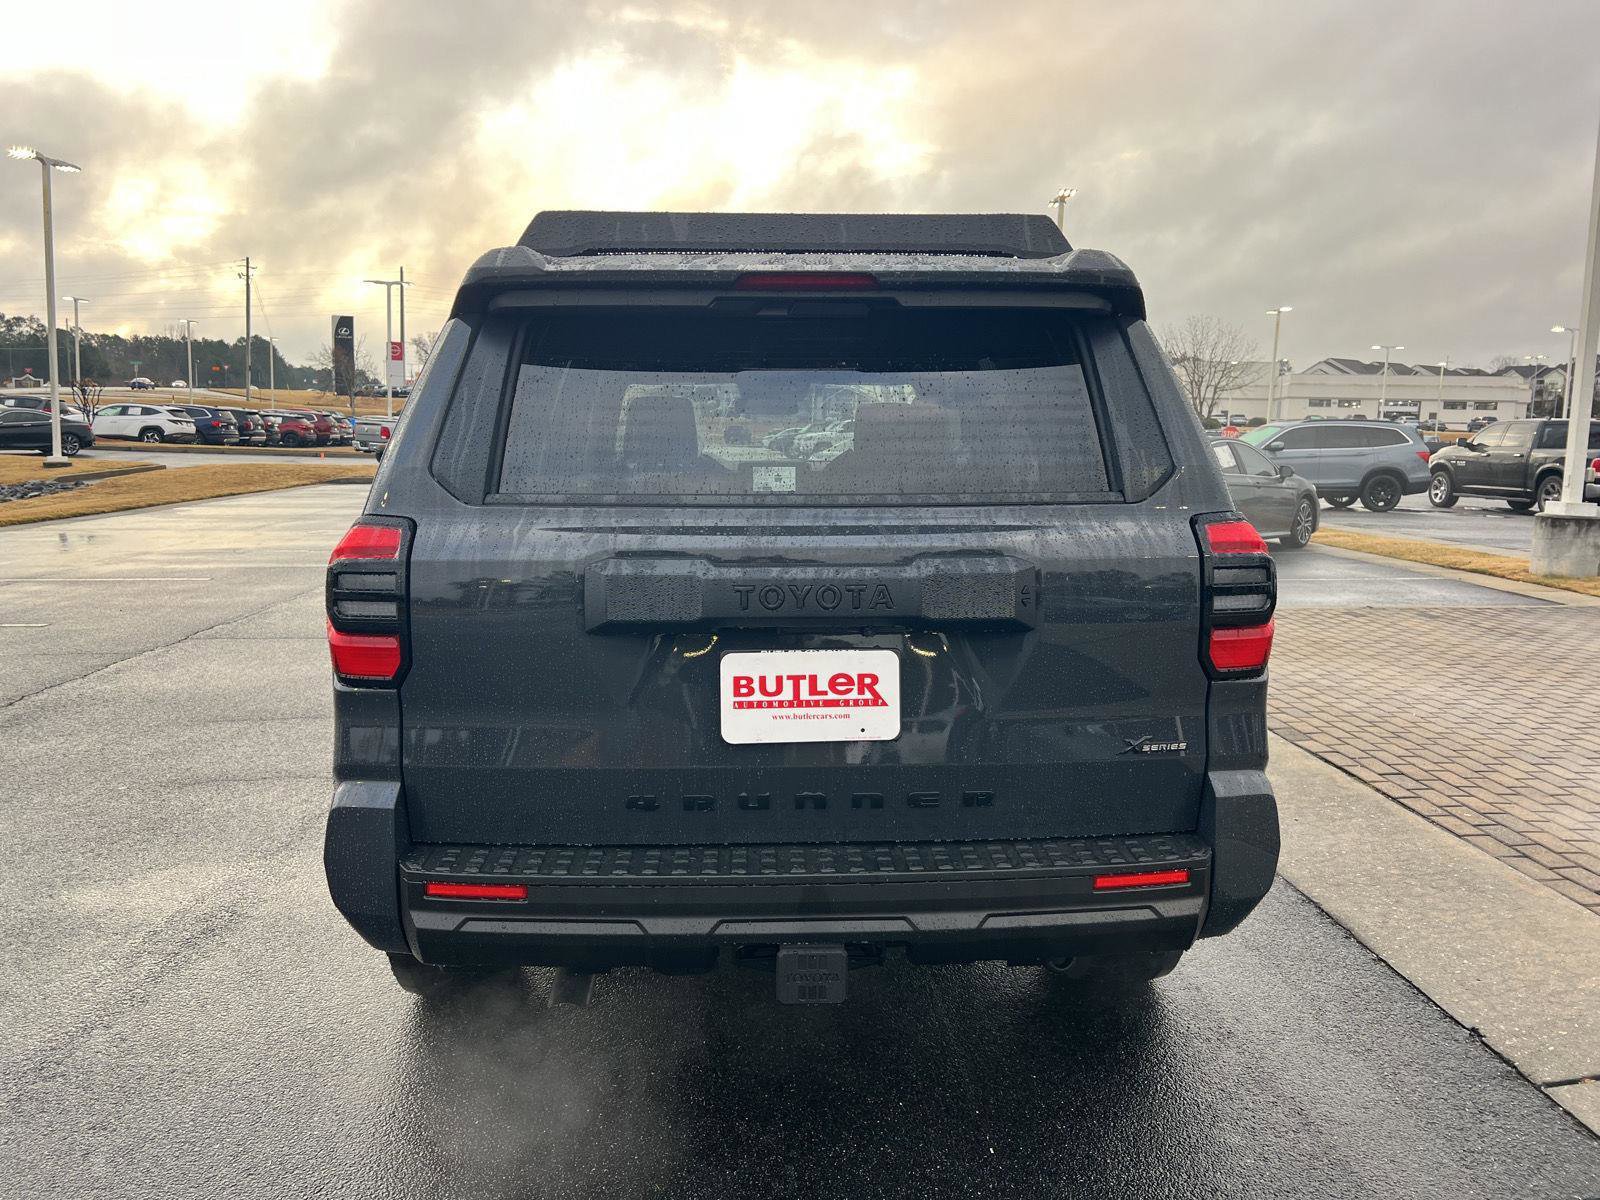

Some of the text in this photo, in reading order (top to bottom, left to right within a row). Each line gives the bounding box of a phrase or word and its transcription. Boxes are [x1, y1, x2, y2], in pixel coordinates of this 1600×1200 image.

[1222, 430, 1239, 438] STOP
[733, 584, 895, 611] TOYOTA
[734, 699, 884, 709] AUTOMOTIVE GROUP
[771, 711, 851, 721] www.butlercars.com
[1141, 742, 1187, 752] SERIES
